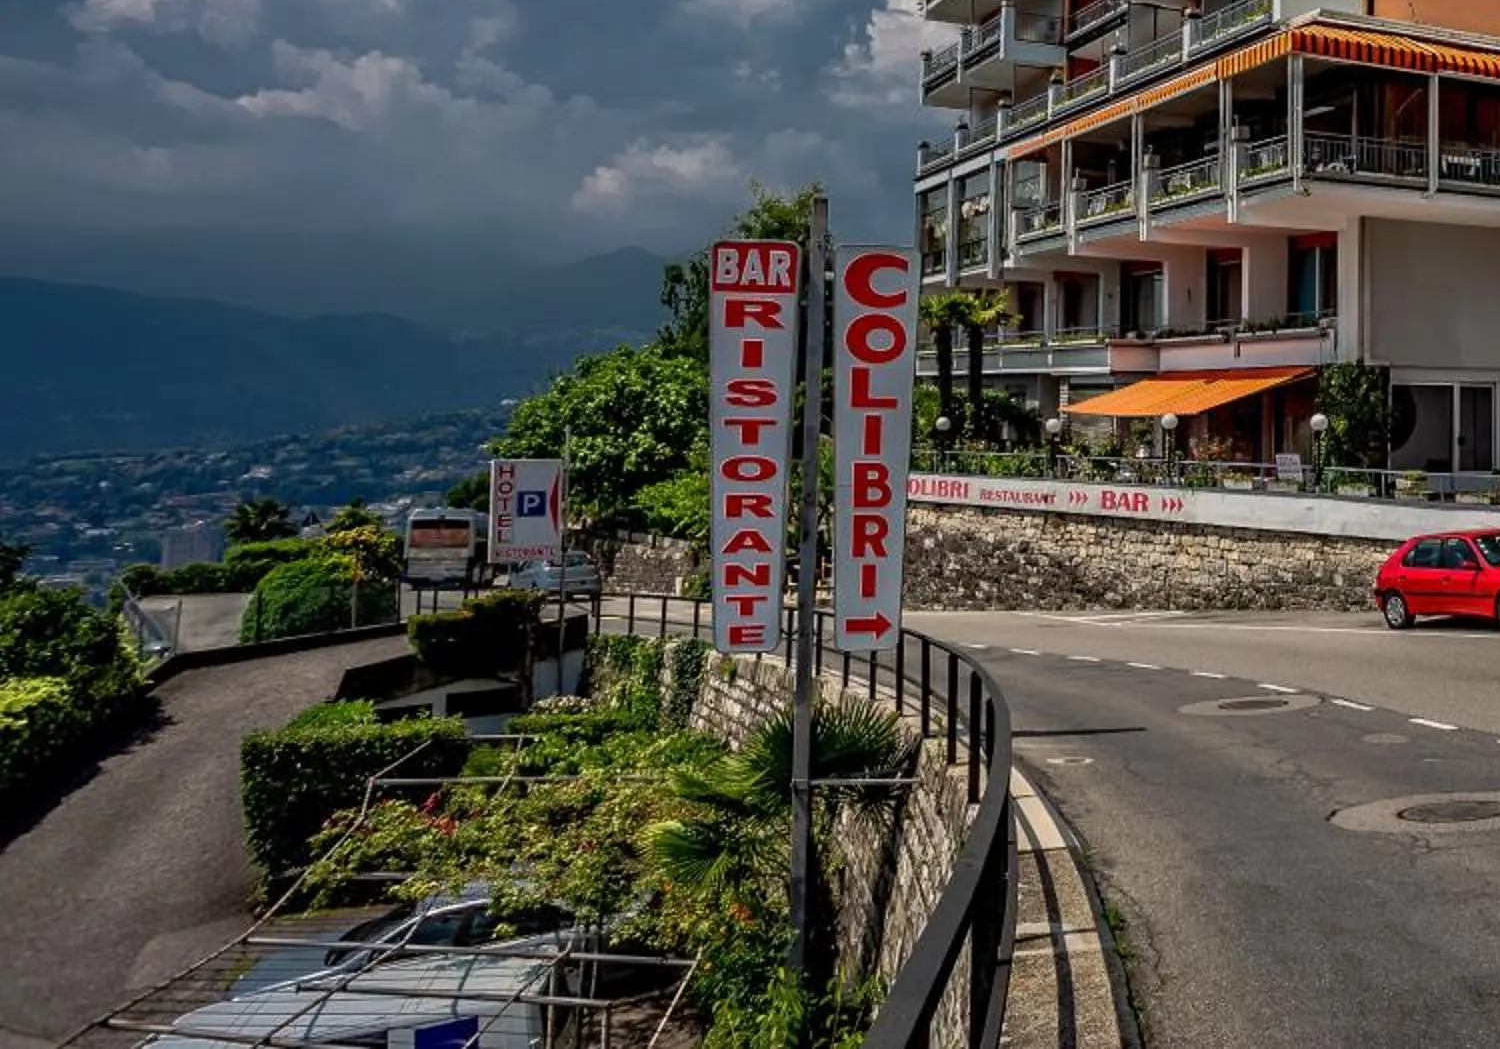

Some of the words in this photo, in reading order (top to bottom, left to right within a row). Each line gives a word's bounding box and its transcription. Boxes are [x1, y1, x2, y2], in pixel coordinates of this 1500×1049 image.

[716, 249, 791, 287] BAR
[844, 253, 909, 599] COLIBRI
[720, 299, 785, 646] RISTORANTE
[908, 478, 968, 499] OLIBRI
[980, 489, 1056, 504] RESTAURANT
[1101, 490, 1149, 512] BAR
[497, 465, 514, 543] HOTEL
[523, 494, 541, 514] P
